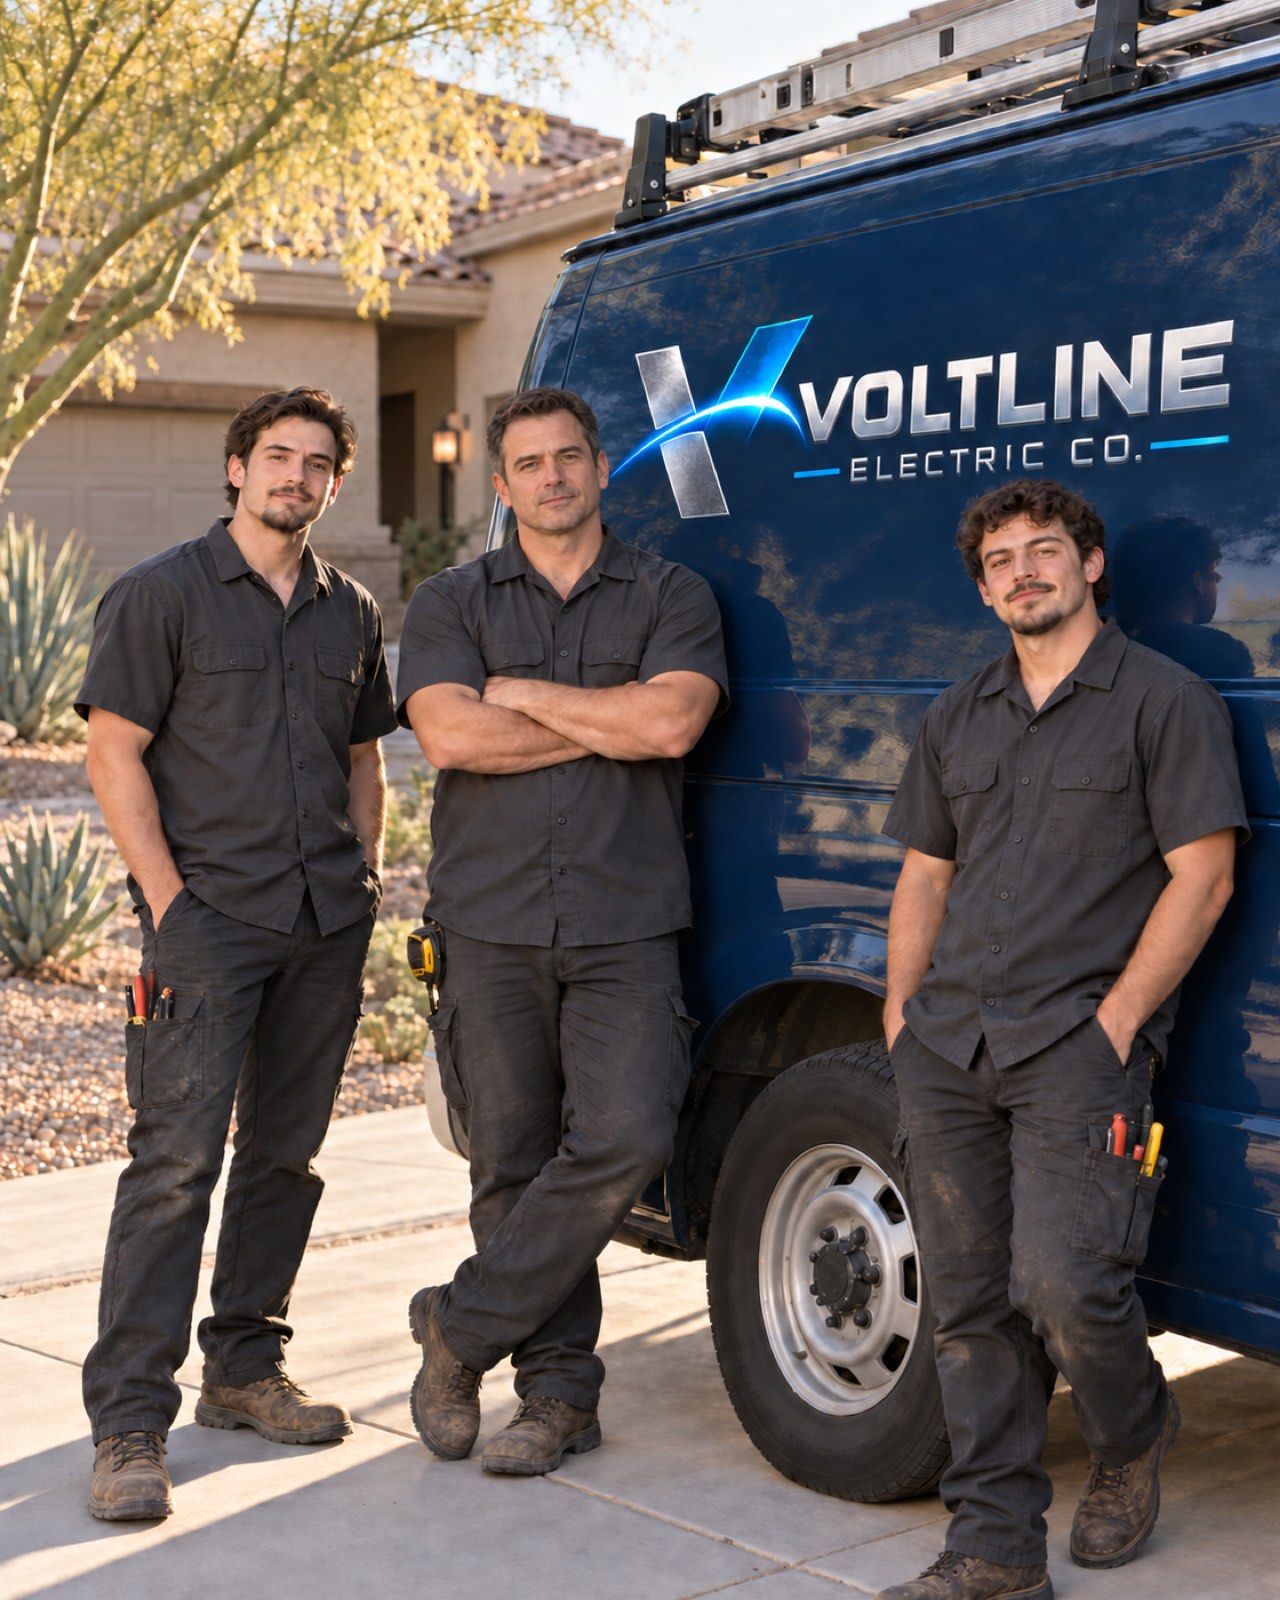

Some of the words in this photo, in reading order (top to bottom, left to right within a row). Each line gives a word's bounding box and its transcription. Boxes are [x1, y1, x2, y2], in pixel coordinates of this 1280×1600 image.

[799, 320, 1234, 442] VOLTLINE
[850, 442, 1044, 482] ELECTRIC
[1071, 434, 1142, 466] CO.
